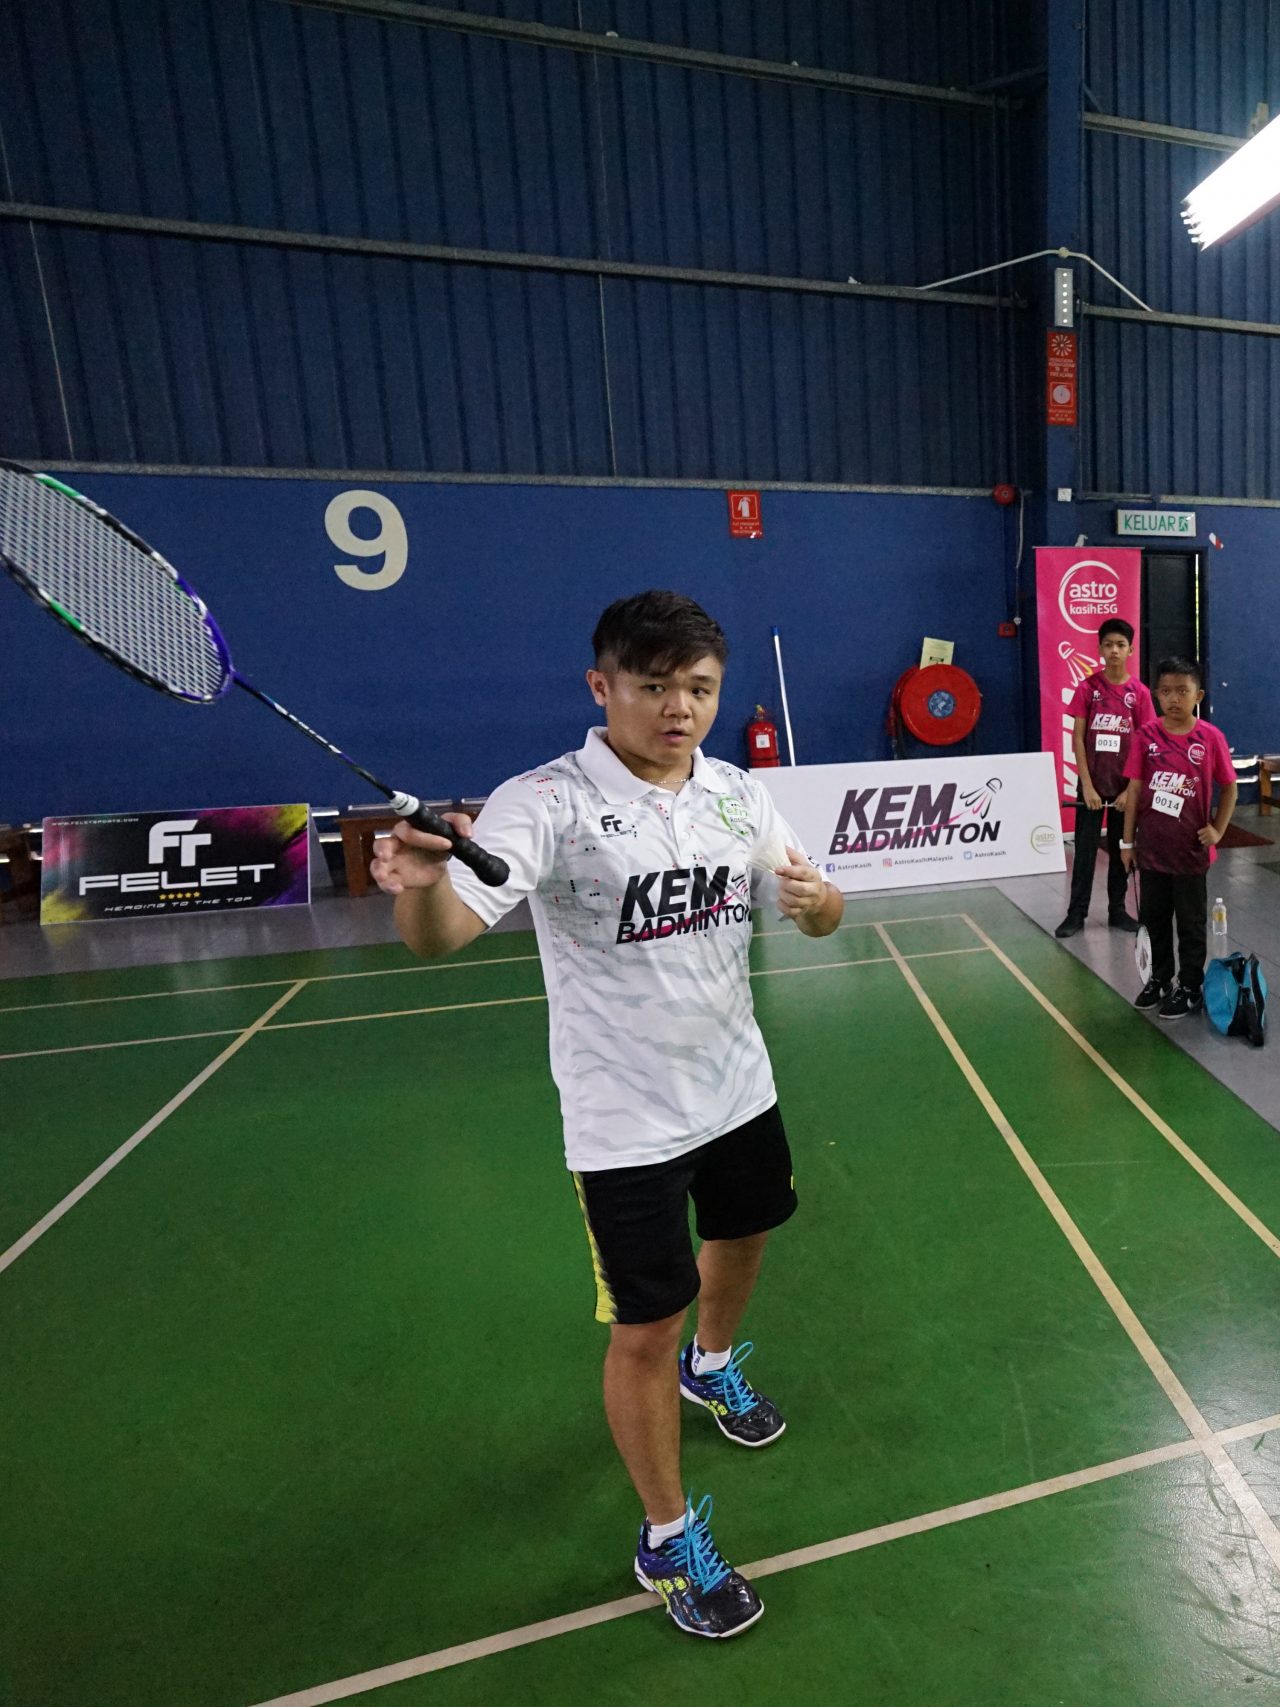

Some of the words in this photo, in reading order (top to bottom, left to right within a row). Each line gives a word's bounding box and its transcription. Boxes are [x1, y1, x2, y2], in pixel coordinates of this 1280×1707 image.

[1124, 514, 1176, 531] KELUAR
[324, 489, 408, 591] 9
[1069, 581, 1118, 599] astro
[1069, 603, 1118, 615] kasihESG
[1092, 713, 1123, 729] KEM
[1097, 739, 1119, 748] 0015
[1150, 770, 1187, 788] KEM
[835, 782, 958, 833] KEM
[1155, 795, 1180, 811] 0014
[828, 820, 1001, 855] BADMINTON
[78, 863, 276, 896] FELET
[620, 865, 731, 922] KEM
